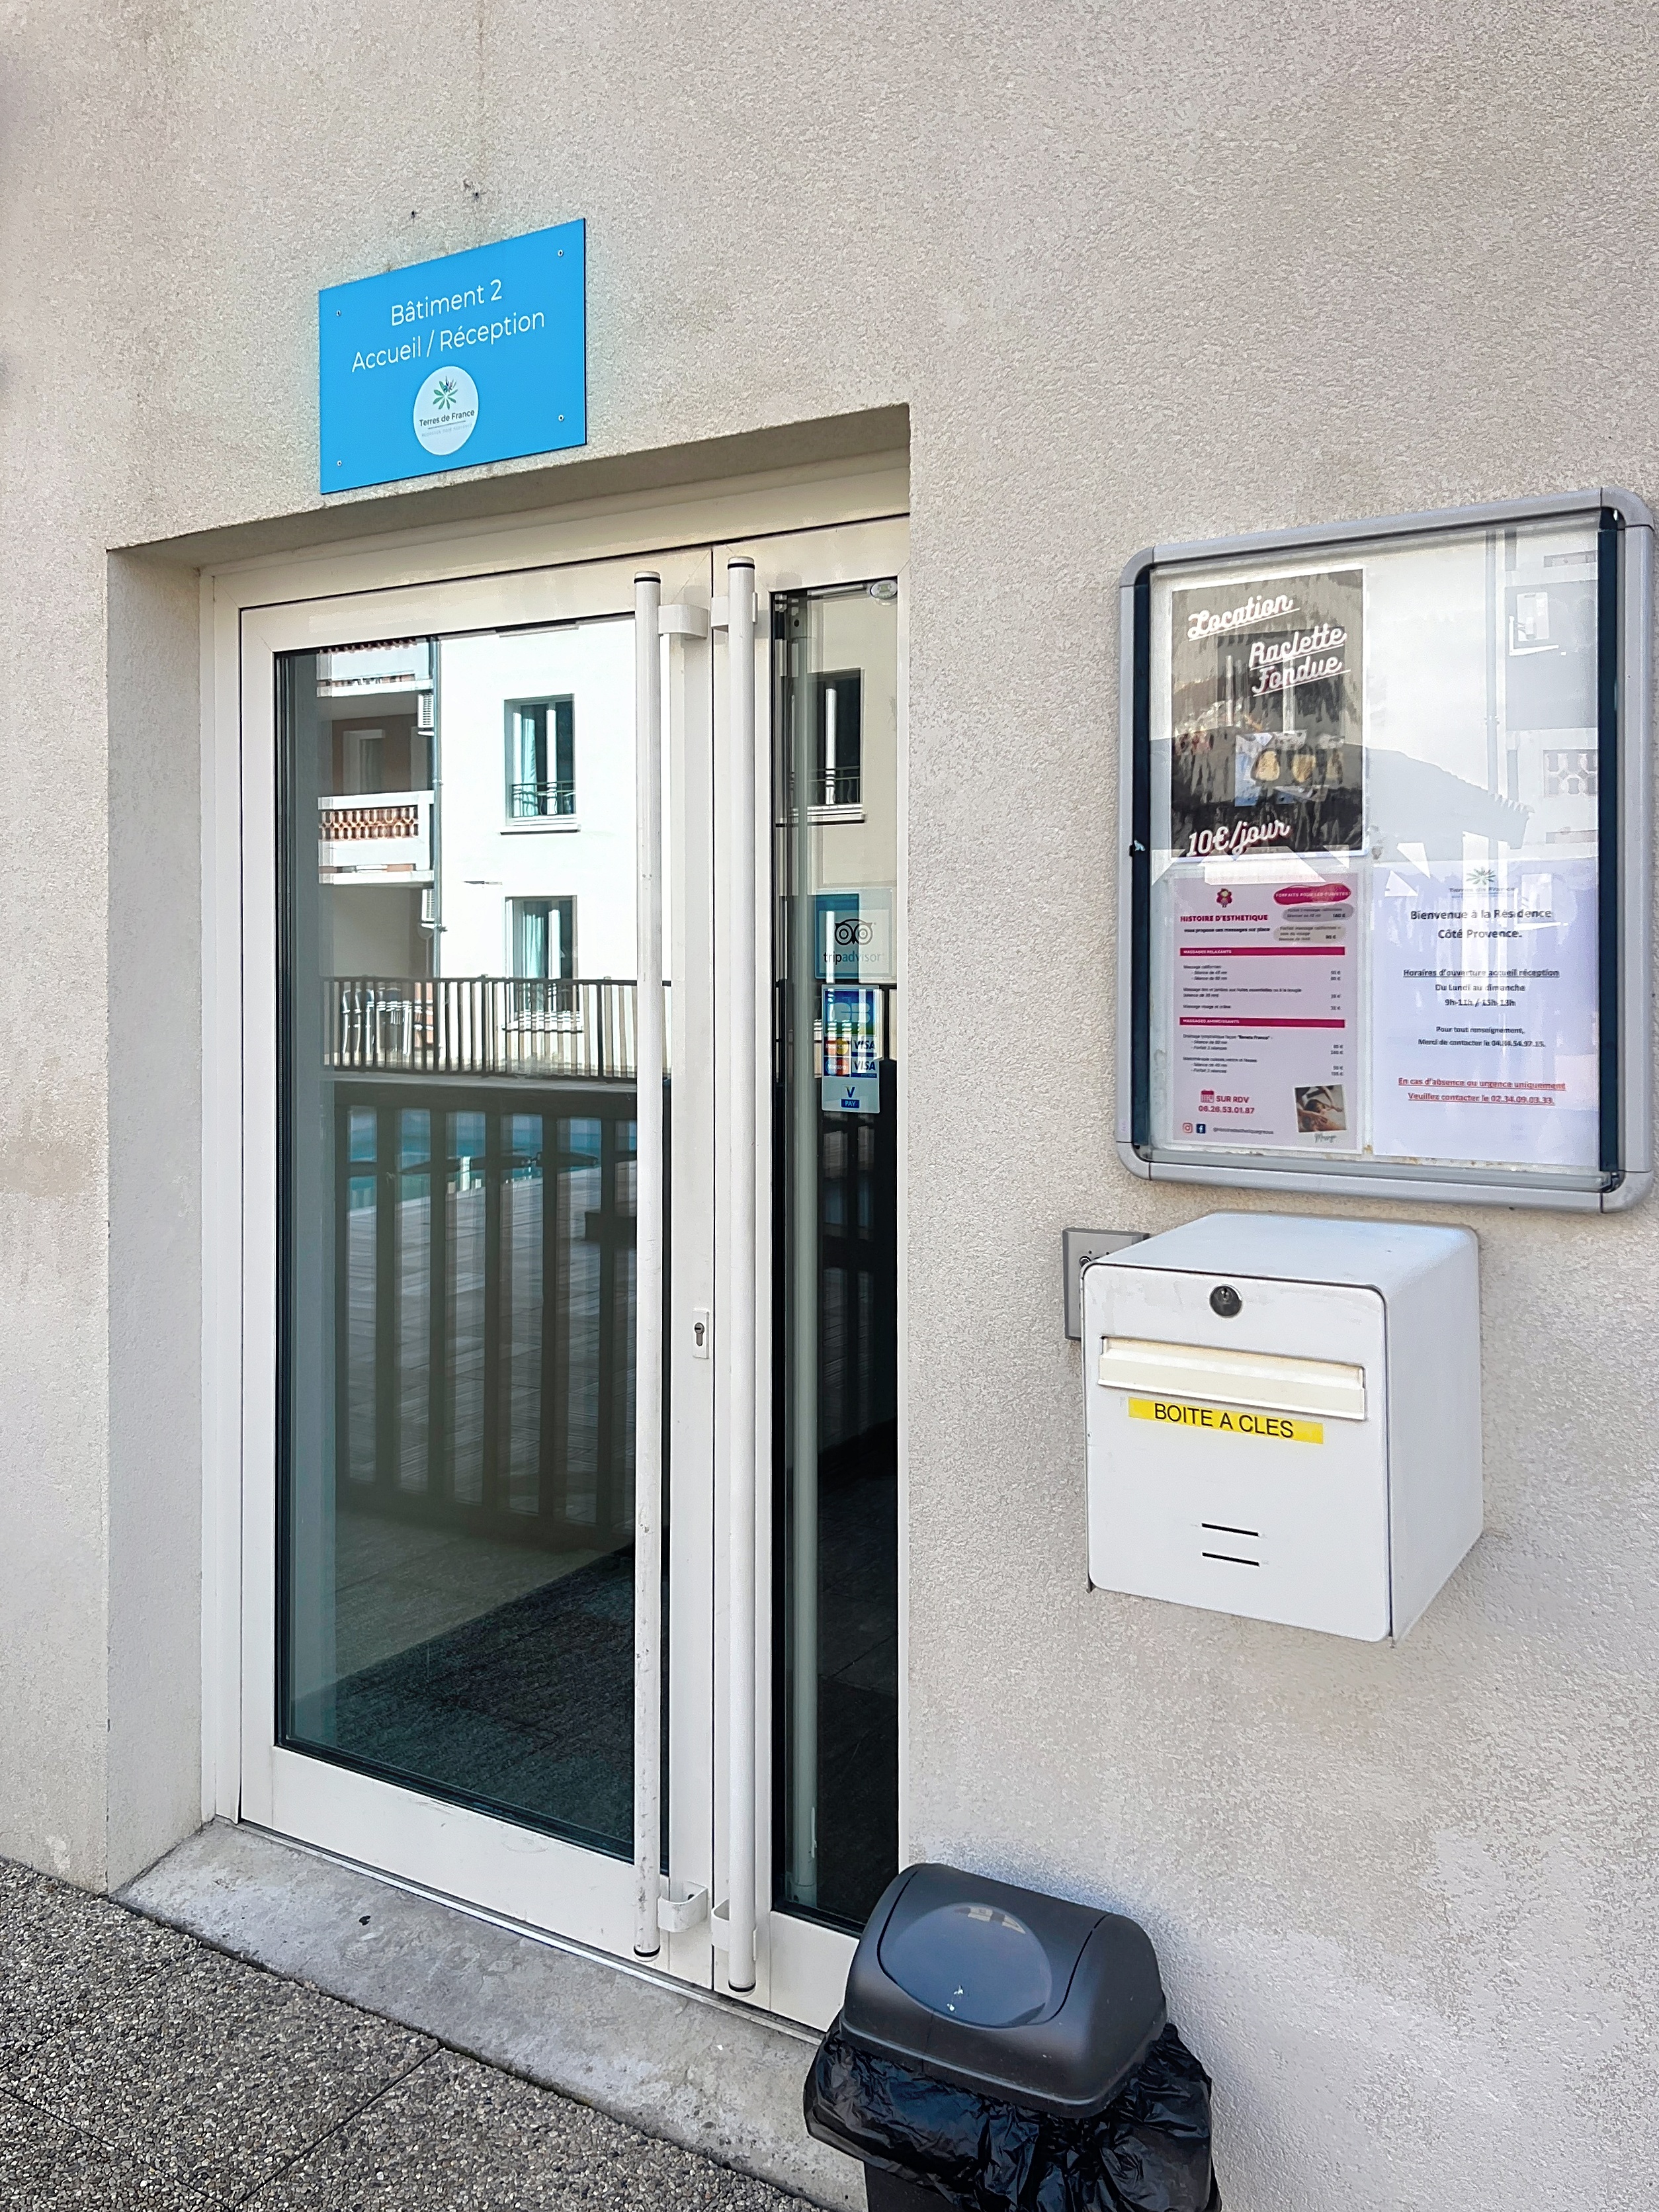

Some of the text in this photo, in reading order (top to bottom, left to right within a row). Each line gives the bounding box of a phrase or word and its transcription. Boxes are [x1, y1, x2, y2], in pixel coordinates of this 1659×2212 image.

[391, 279, 503, 326] Bâtiment 2
[352, 310, 544, 373] Accueil / Réception
[419, 417, 440, 427] Terres
[451, 410, 475, 420] France
[1188, 594, 1295, 640] Location
[1249, 623, 1348, 669] Raclette
[1252, 656, 1344, 695] Fondue
[1186, 820, 1293, 859] 10€/jour
[1410, 909, 1552, 919] Bienvenue à la Résidence
[1438, 928, 1523, 939] Côté Provence.
[823, 951, 881, 964] tripadvisor
[1439, 968, 1486, 977] d'ouverture
[1519, 969, 1559, 978] réception
[853, 1040, 876, 1050] VISA
[853, 1060, 876, 1071] VISA
[845, 1085, 855, 1098] V
[1514, 1082, 1566, 1090] uniquement
[1154, 1402, 1295, 1439] BOITE A CLES
